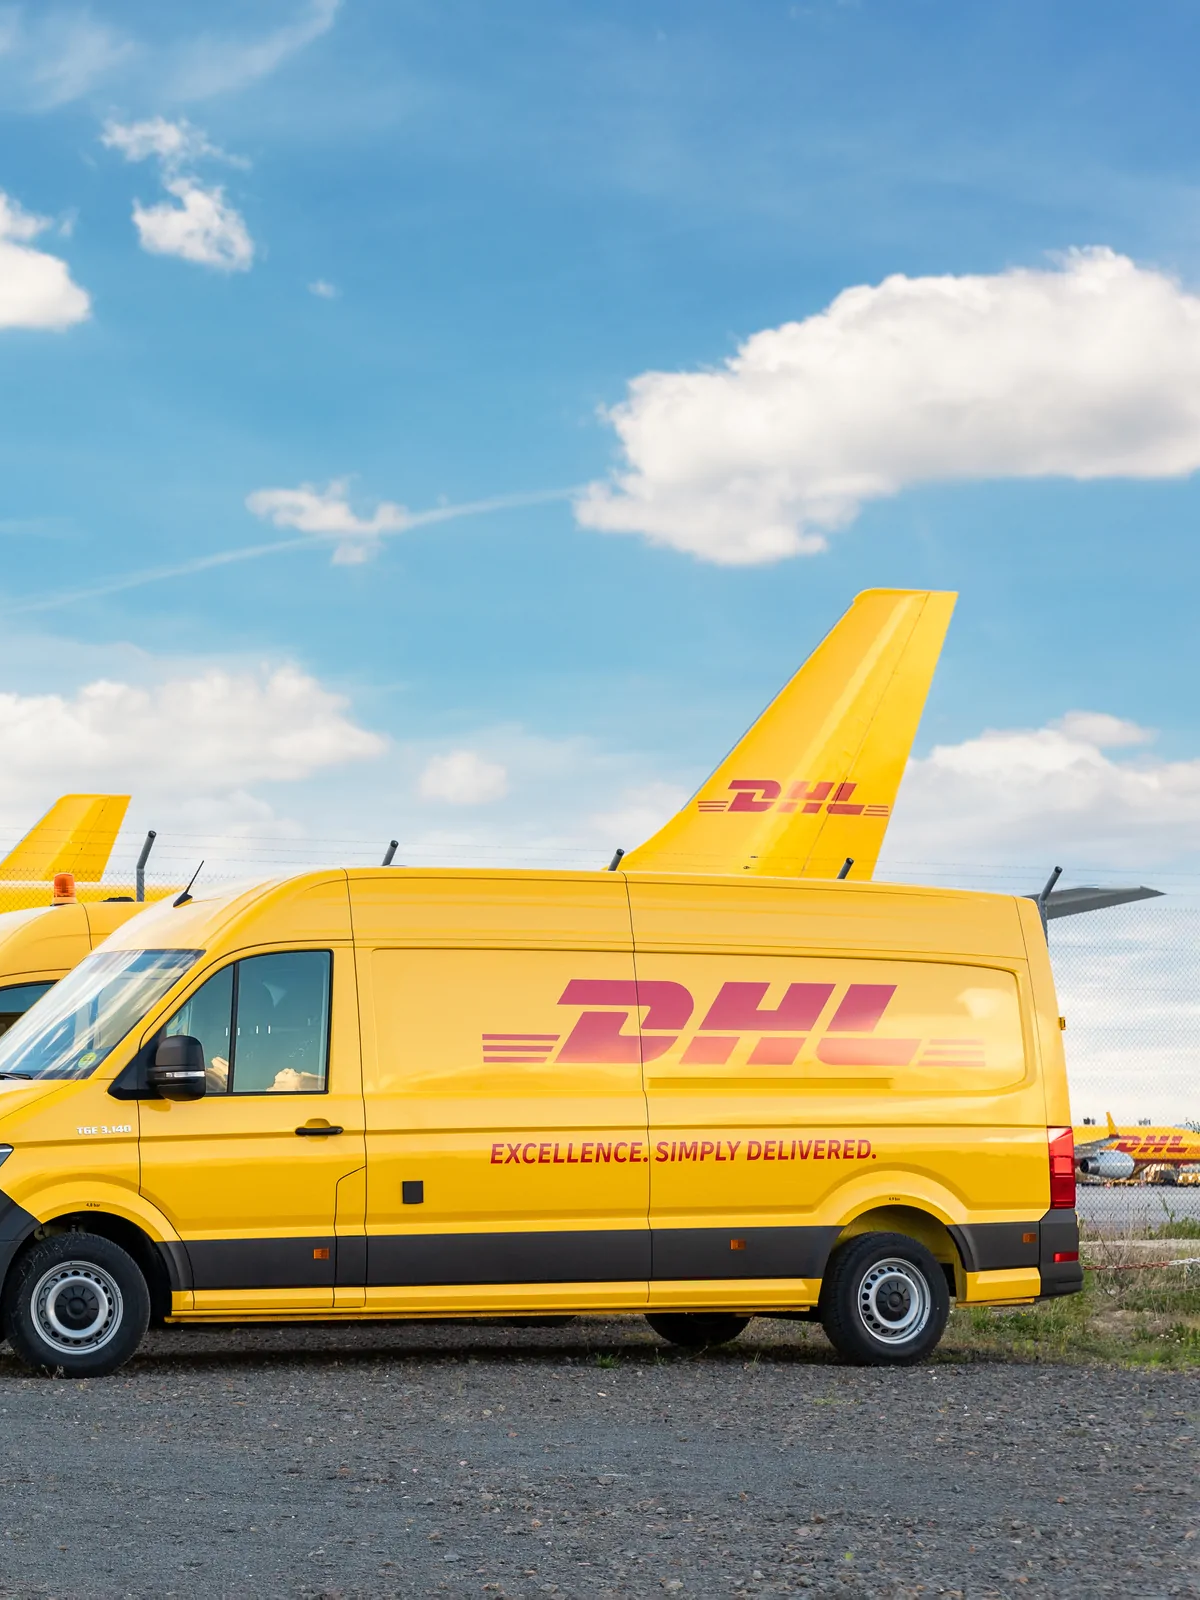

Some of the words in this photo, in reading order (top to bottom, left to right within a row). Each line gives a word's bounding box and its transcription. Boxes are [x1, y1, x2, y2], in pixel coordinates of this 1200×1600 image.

[727, 779, 866, 816] DHL
[553, 978, 922, 1066] DHL
[77, 1127, 98, 1135] TGE
[101, 1125, 132, 1134] 3.140
[489, 1141, 649, 1165] EXCELLENCE.
[654, 1140, 741, 1163] SIMPLY
[746, 1138, 877, 1162] DELIVERED.
[1114, 1135, 1189, 1153] DHL
